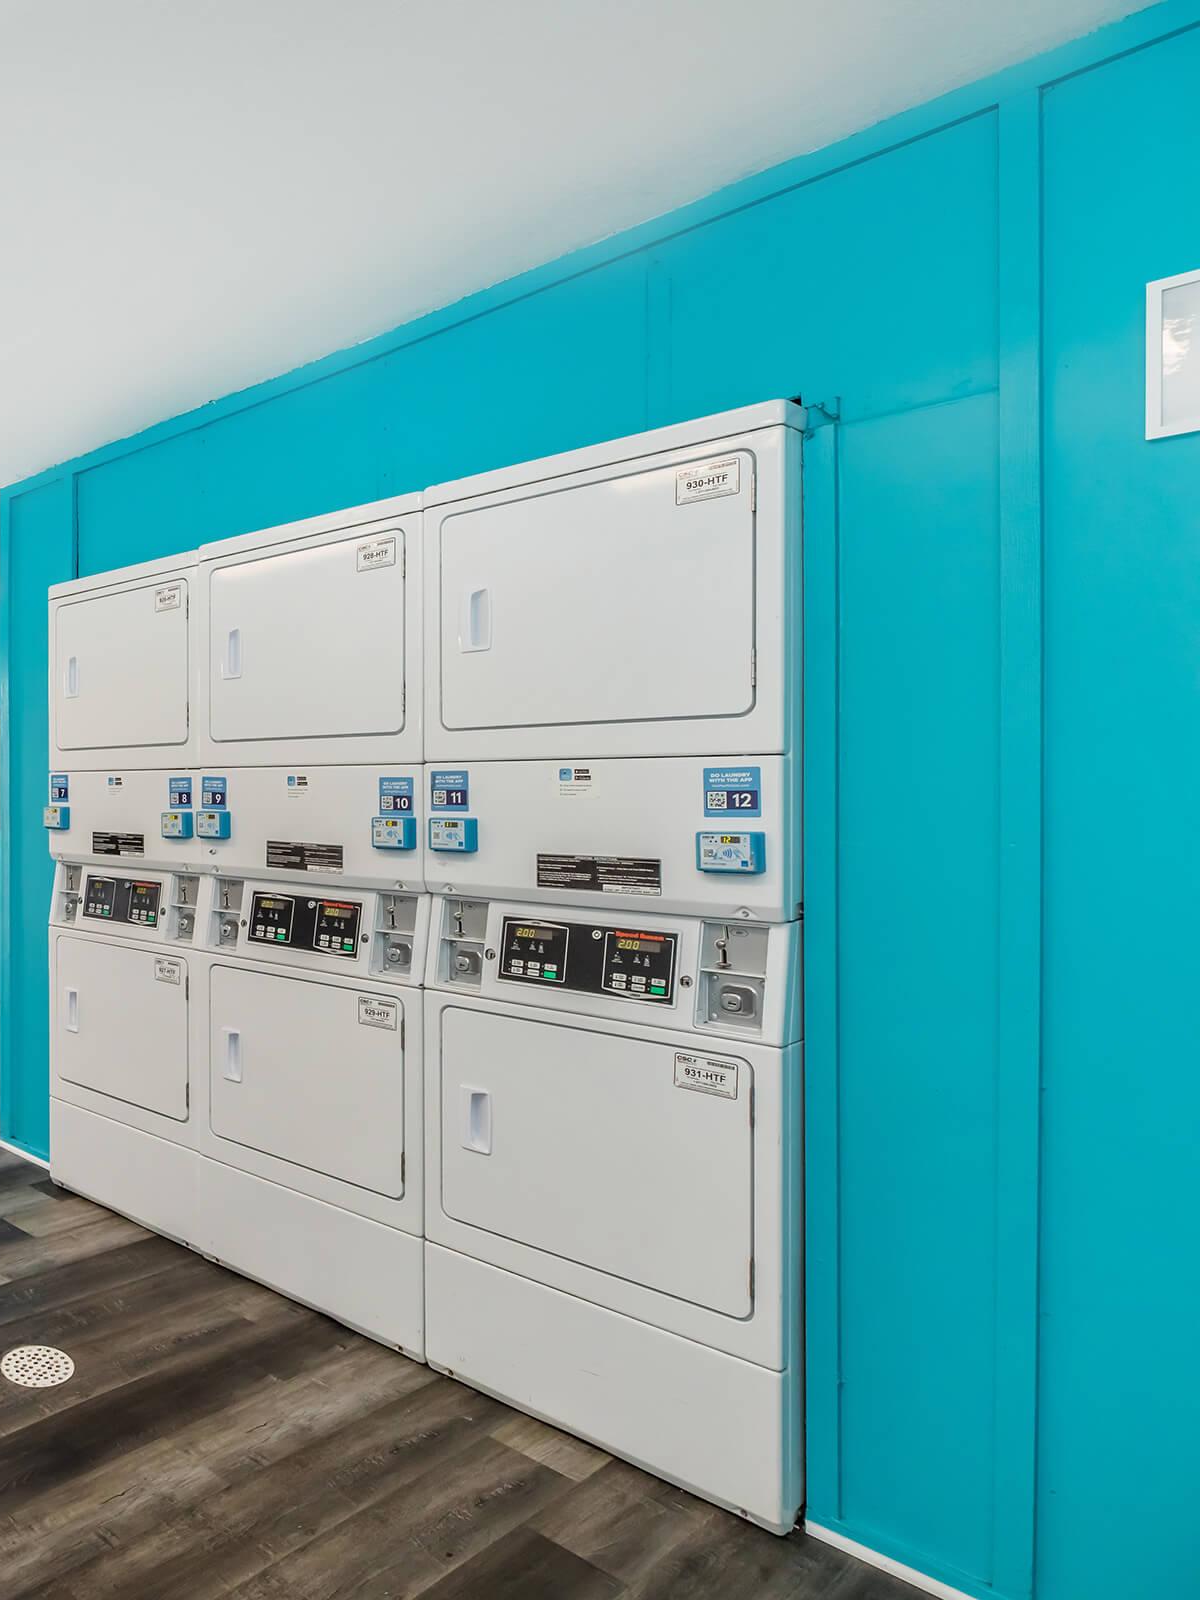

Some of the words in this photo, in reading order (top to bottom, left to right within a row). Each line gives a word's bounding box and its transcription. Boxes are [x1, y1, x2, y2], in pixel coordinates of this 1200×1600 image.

[686, 473, 728, 489] 930-HTF
[60, 788, 65, 798] 7
[181, 793, 187, 803] 8
[215, 793, 221, 803] 9
[450, 791, 461, 804] 11
[395, 797, 409, 809] 10
[731, 793, 752, 808] 12
[684, 1067, 726, 1083] 931-HTF
